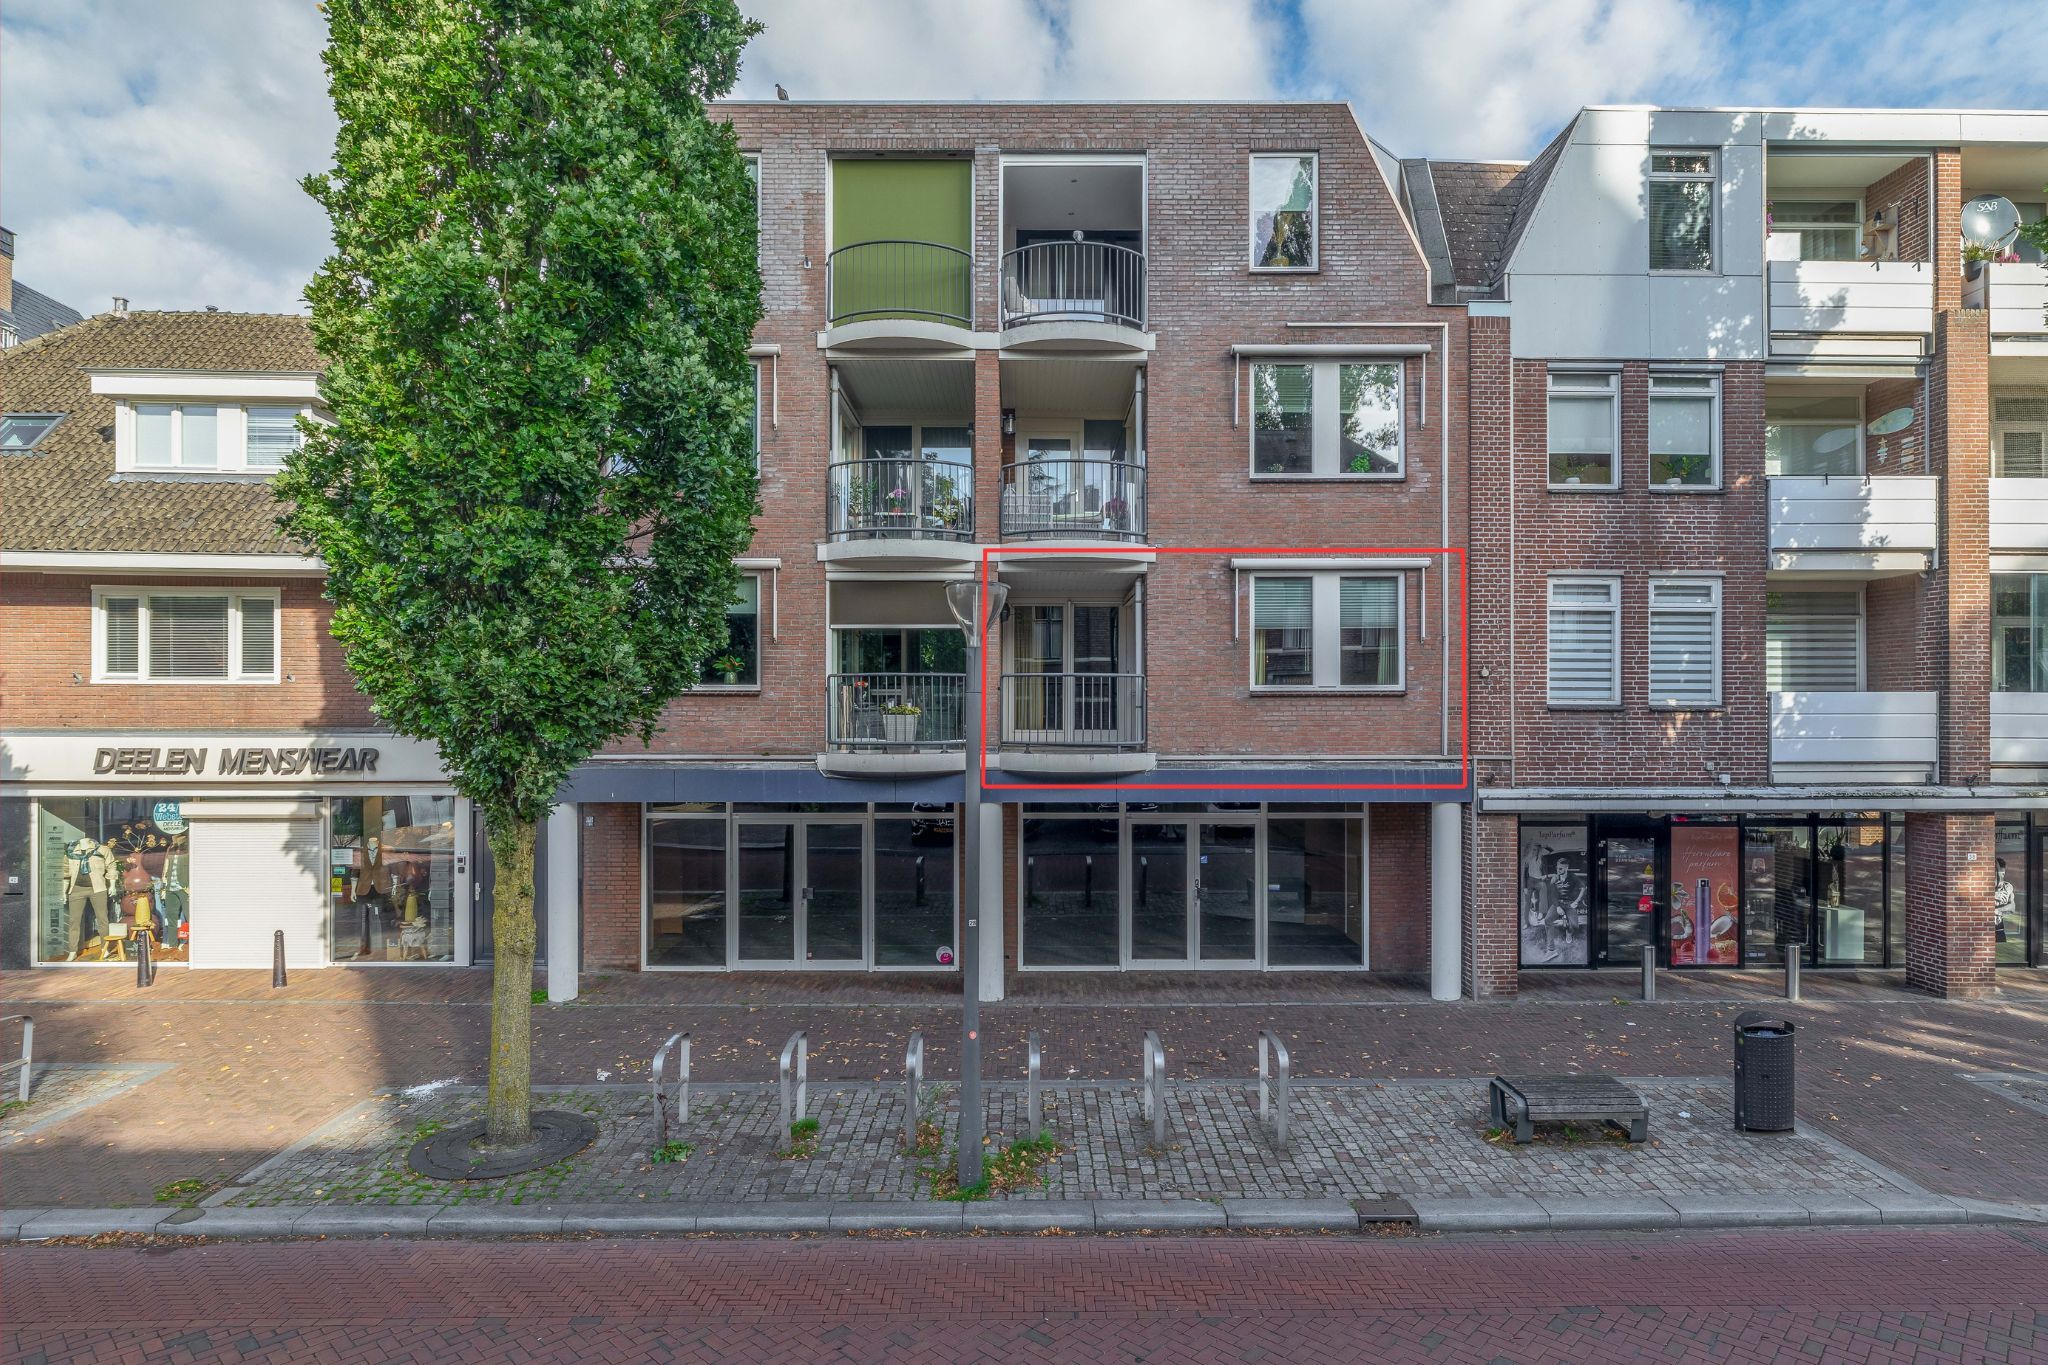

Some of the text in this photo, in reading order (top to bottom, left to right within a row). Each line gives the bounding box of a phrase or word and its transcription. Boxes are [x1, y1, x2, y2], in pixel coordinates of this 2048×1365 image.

[1977, 201, 1998, 212] SAB
[93, 748, 380, 775] DEELEN MENSWEAR
